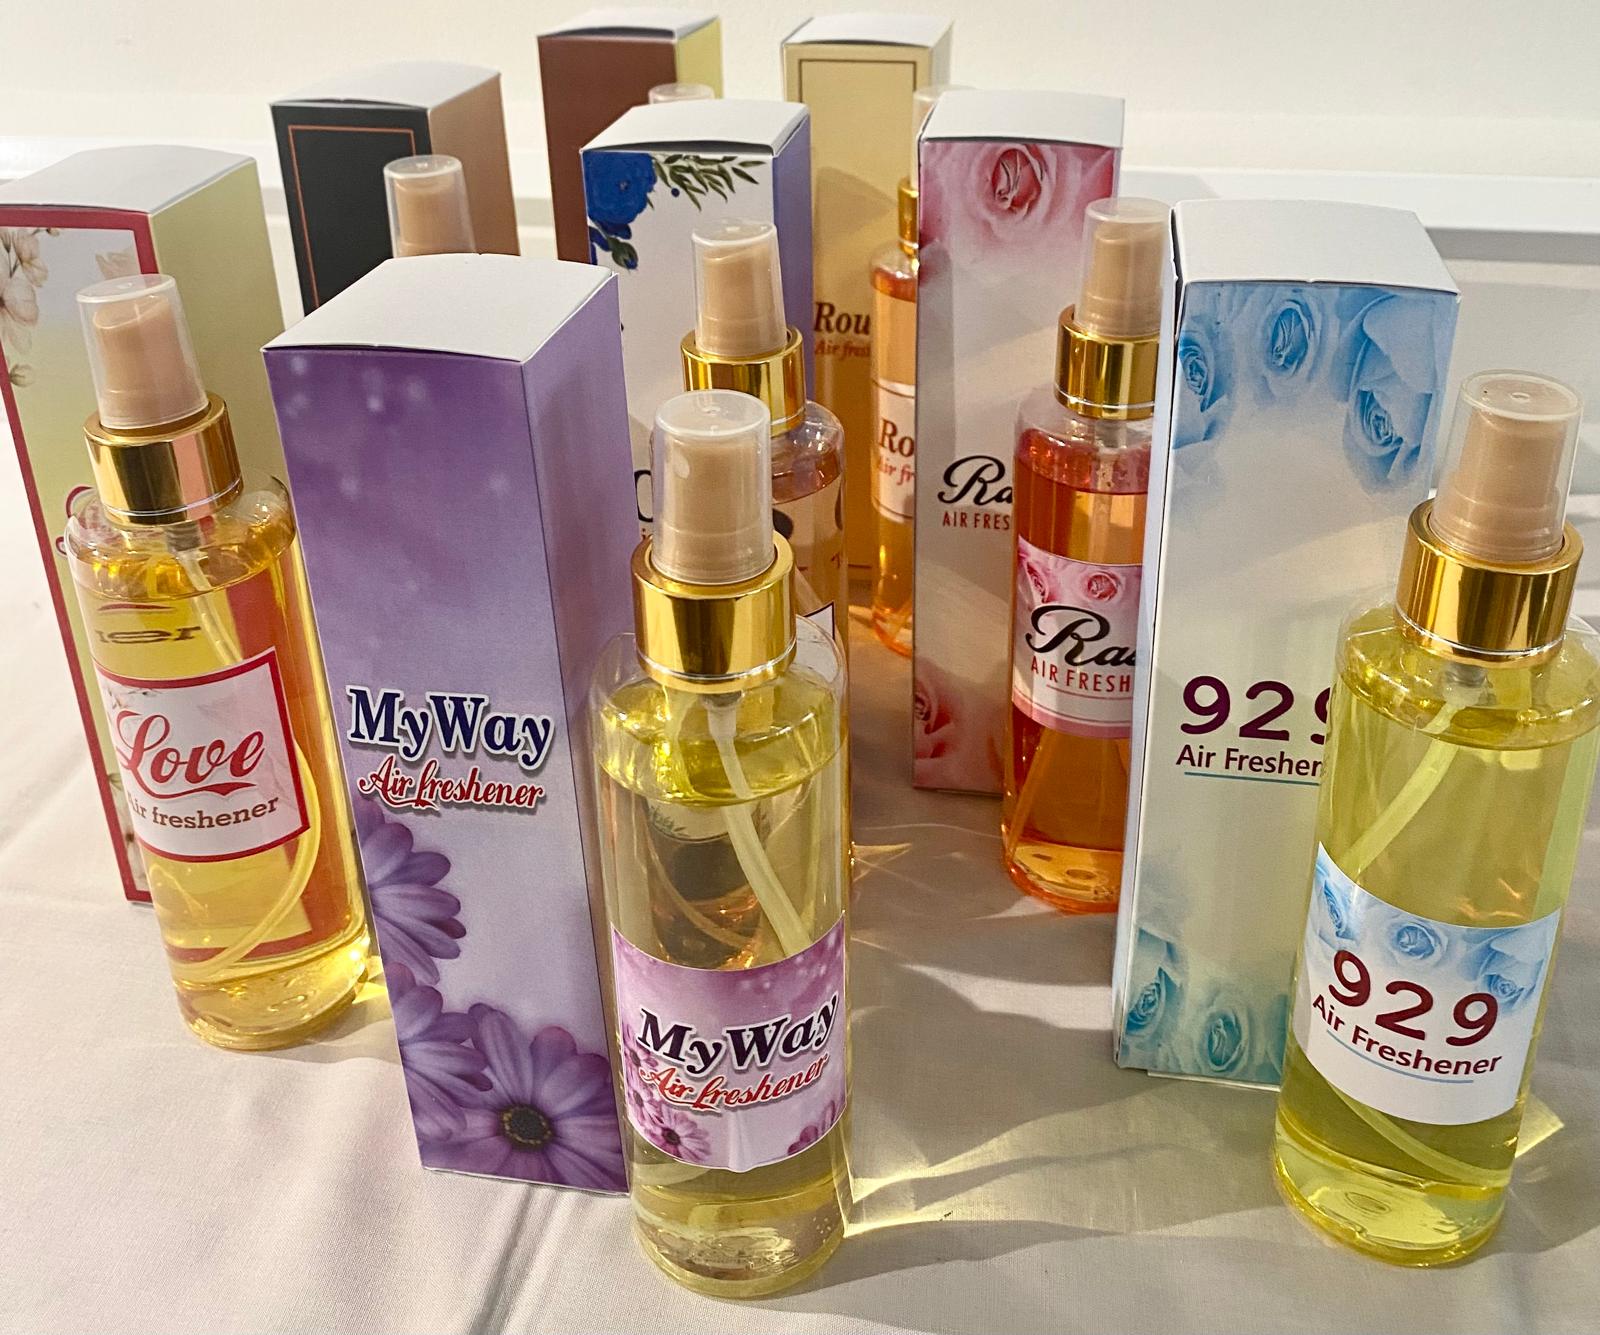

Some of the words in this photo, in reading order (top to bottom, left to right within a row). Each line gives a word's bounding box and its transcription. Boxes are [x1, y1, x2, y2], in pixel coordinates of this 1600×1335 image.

[814, 301, 871, 336] Rou
[879, 417, 915, 458] Ro
[942, 510, 968, 528] AIR
[973, 511, 1011, 531] FRES
[1030, 655, 1059, 683] AIR
[1066, 669, 1131, 692] FRESH
[348, 686, 552, 768] MyWay
[116, 709, 266, 800] Love
[358, 754, 414, 807] Air
[414, 759, 544, 808] freshener
[1175, 743, 1217, 769] Air
[152, 796, 280, 829] freshener
[1327, 949, 1499, 1047] 929
[636, 994, 838, 1075] MyWay
[1312, 993, 1346, 1032] Air
[1351, 1024, 1503, 1076] Freshener
[639, 1067, 695, 1104] Air
[693, 1053, 829, 1110] freshener
